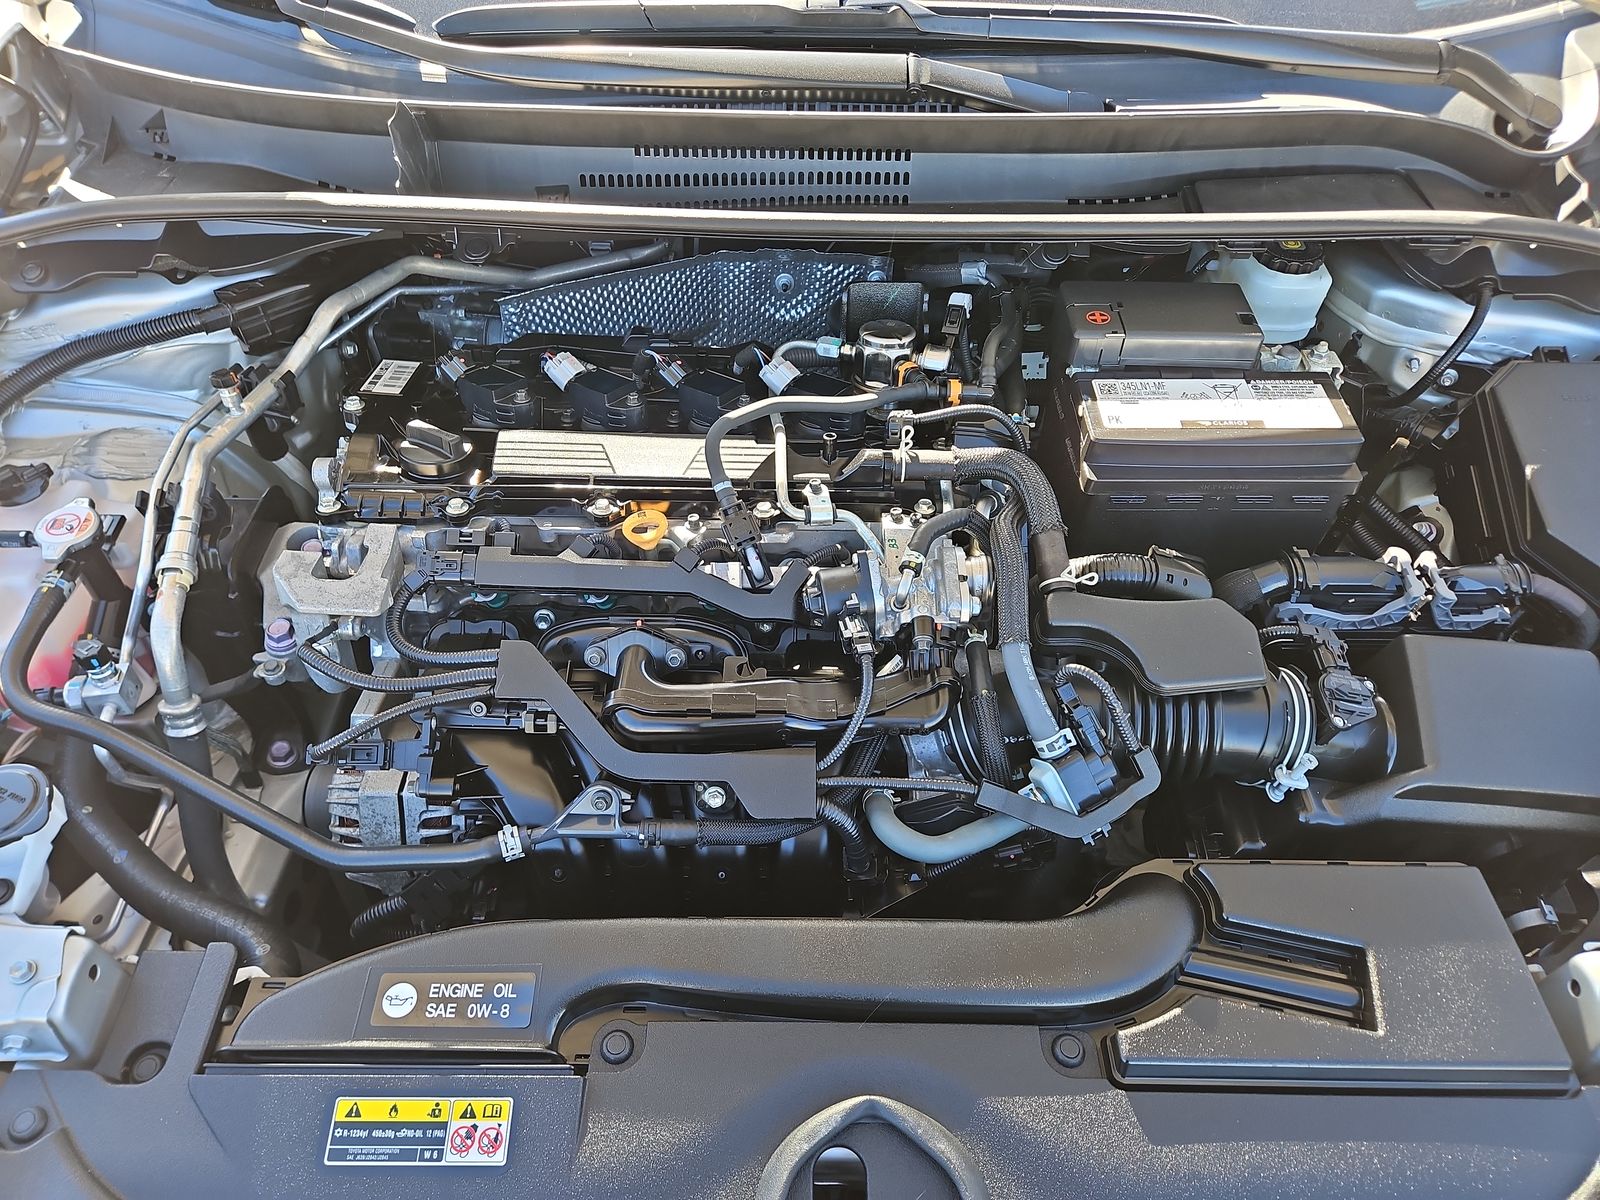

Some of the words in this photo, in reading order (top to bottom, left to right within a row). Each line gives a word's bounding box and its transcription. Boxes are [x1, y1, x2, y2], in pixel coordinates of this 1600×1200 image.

[1121, 382, 1167, 391] 345LN1-MF
[1107, 415, 1123, 424] PK
[428, 983, 485, 998] ENGINE
[493, 983, 517, 998] OIL
[425, 1003, 457, 1018] SAE
[467, 1003, 511, 1019] 0W-8
[424, 1150, 431, 1159] W
[432, 1150, 438, 1159] 6
